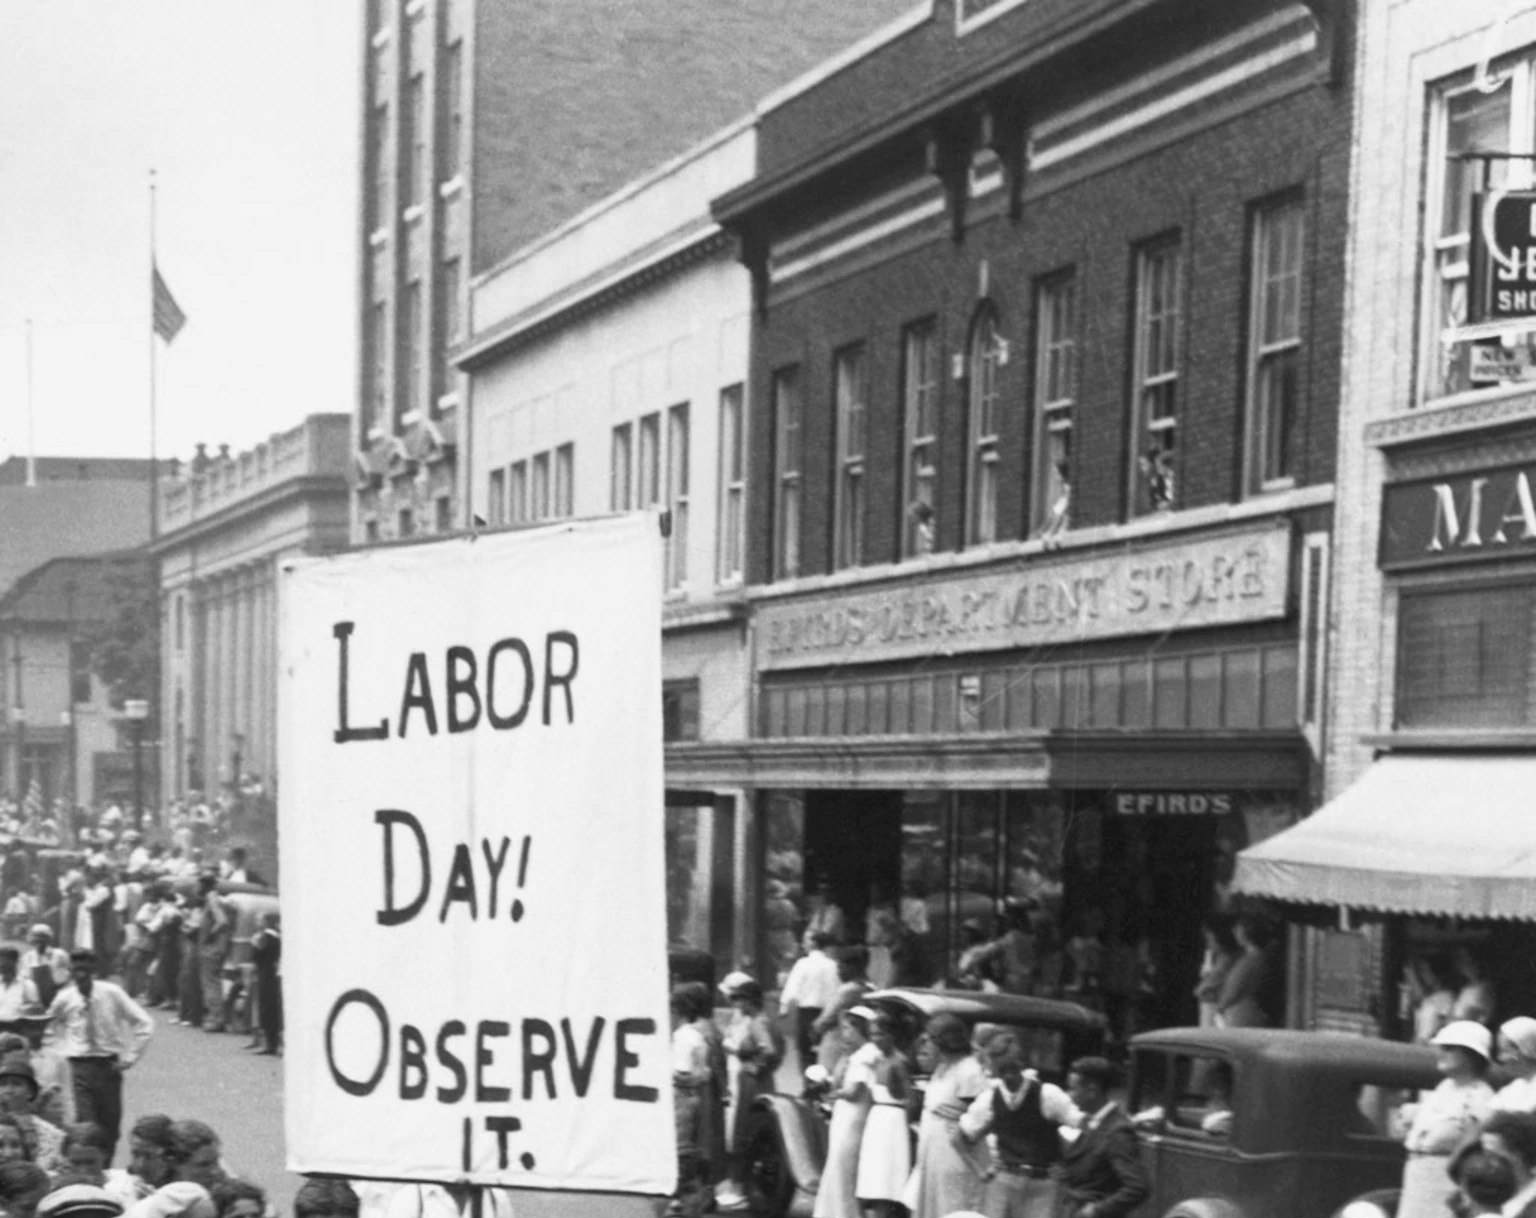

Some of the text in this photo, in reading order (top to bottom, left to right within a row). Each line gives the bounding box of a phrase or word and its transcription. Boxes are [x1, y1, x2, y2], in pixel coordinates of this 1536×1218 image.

[877, 576, 1105, 642] DEPARTMENT
[1127, 551, 1263, 613] STORE
[334, 621, 580, 744] LABOR
[374, 809, 531, 926] DAY!
[325, 989, 660, 1104] OBSERVE
[462, 1116, 536, 1173] IT.
